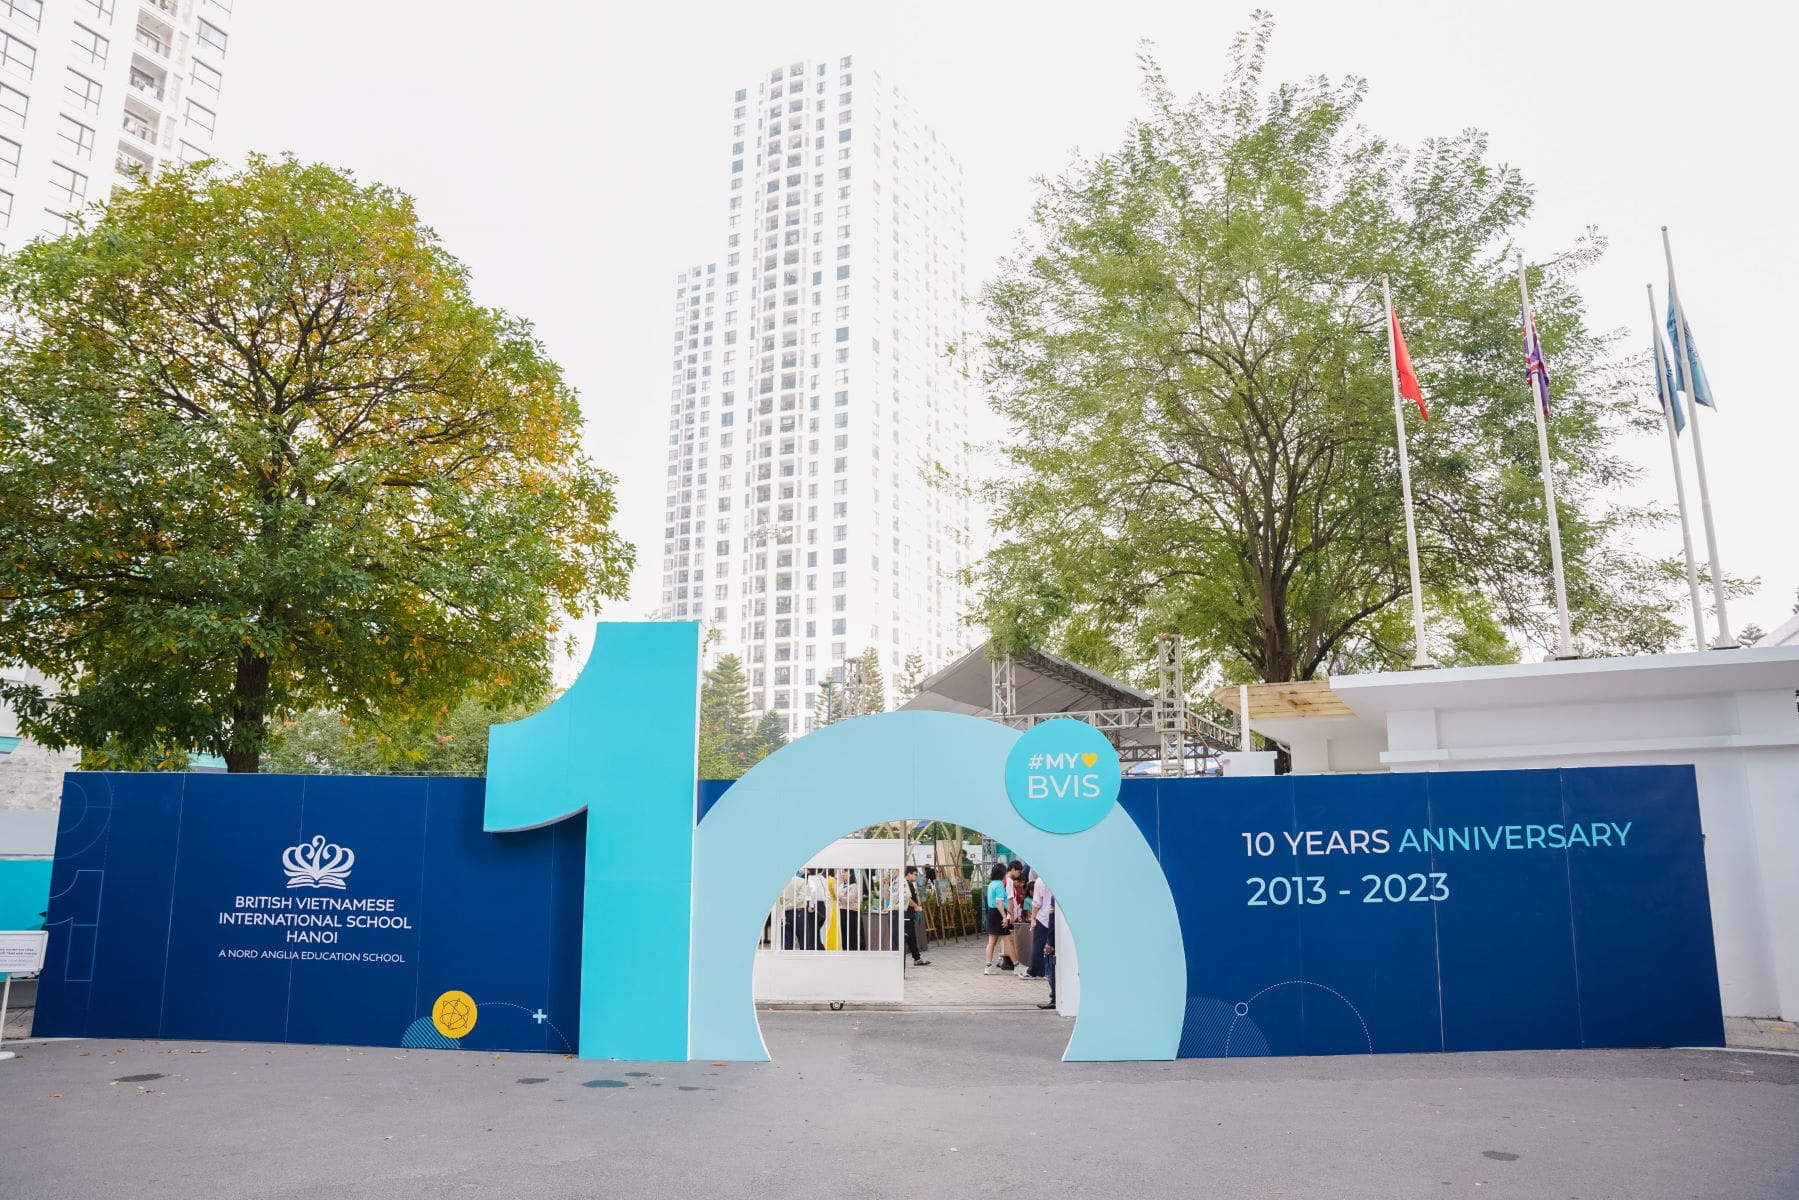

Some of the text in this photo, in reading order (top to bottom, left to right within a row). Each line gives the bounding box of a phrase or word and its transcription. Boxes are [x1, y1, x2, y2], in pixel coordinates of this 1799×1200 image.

[1028, 753, 1079, 769] #MY
[1028, 774, 1101, 799] BVIS
[1241, 821, 1633, 858] 10 YEARS ANNIVERSARY
[1245, 876, 1328, 906] 2013
[1361, 872, 1450, 904] 2023
[235, 895, 395, 912] BRITISH VIETNAMESE
[218, 912, 412, 930] INTERNATIONAL SCHOOL
[286, 930, 339, 944] HANOI
[218, 949, 406, 963] A NORD ANGLIA EDUCATION SCHOOL
